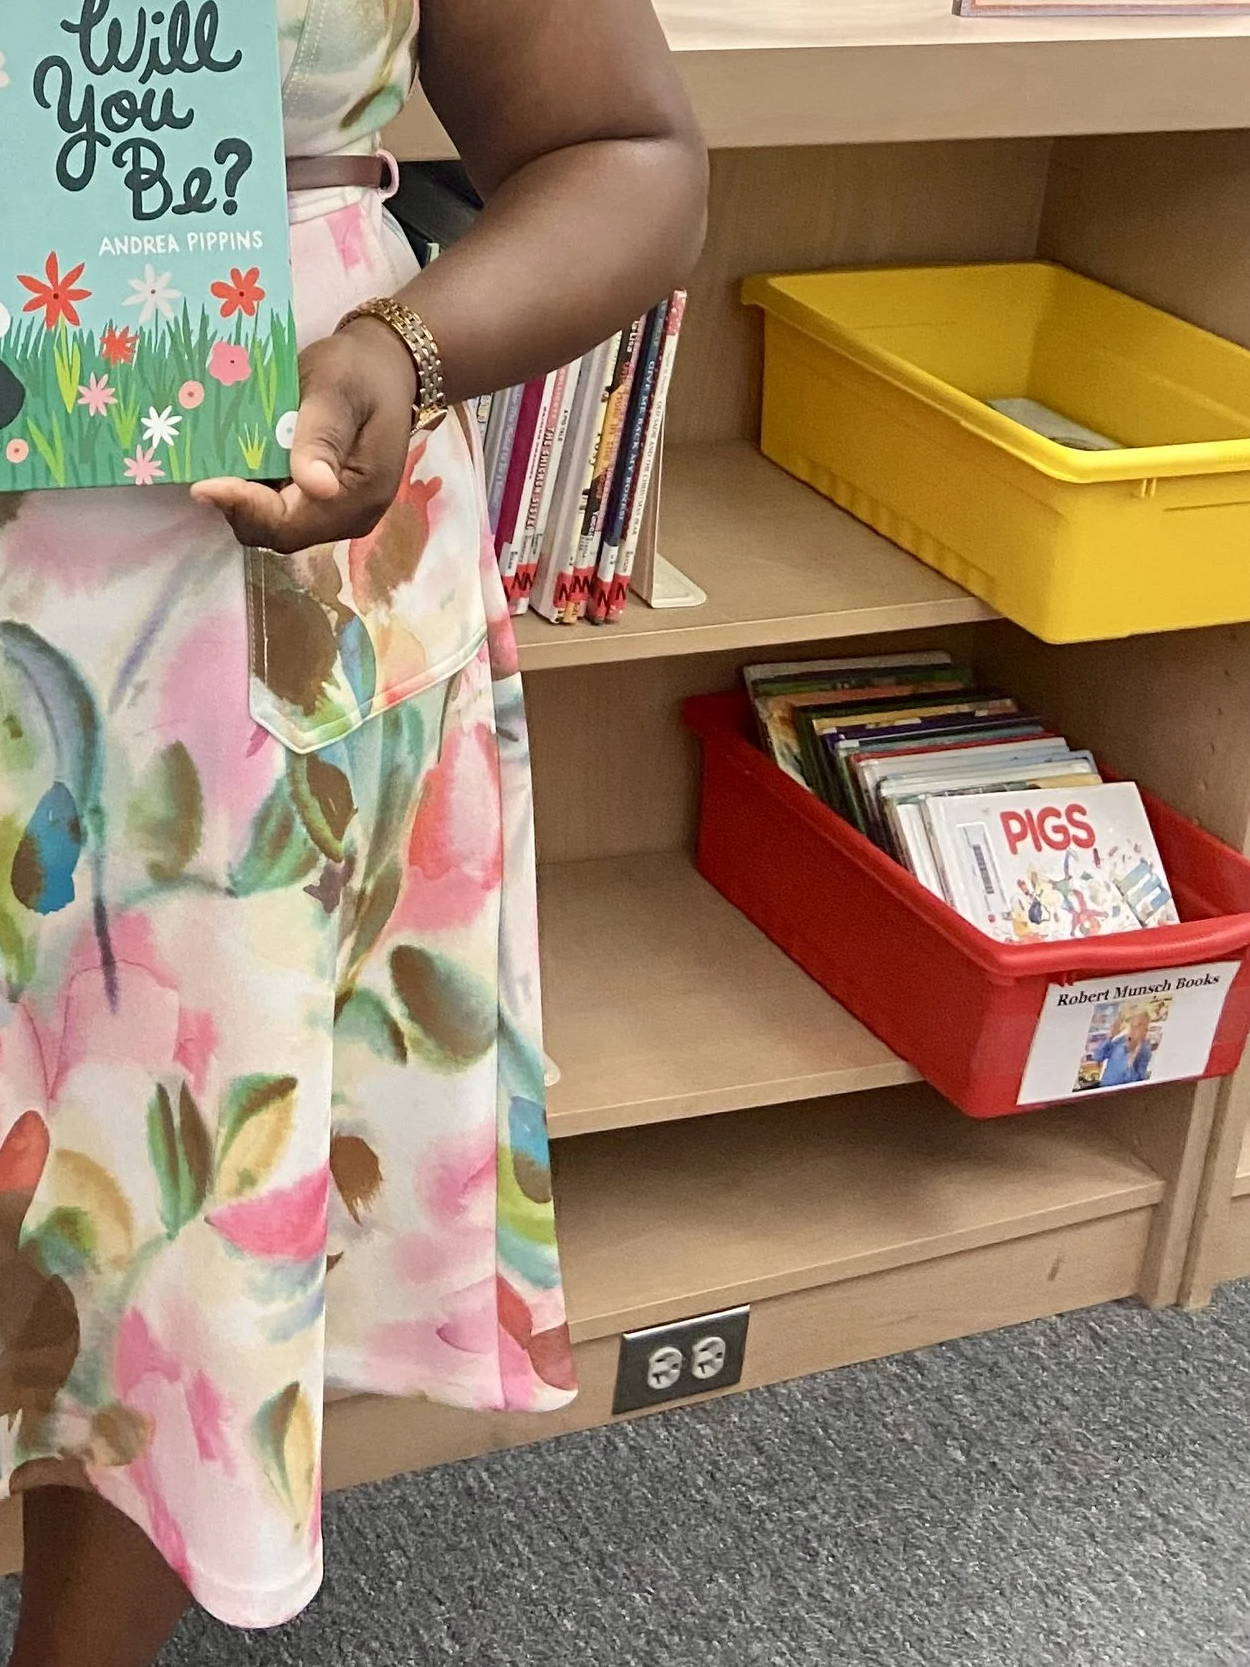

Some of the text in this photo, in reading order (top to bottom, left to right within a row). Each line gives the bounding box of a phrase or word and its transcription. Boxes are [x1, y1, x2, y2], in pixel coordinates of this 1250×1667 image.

[33, 55, 195, 192] You
[112, 137, 253, 222] Be?
[99, 230, 263, 257] ANDREA PIPPINS
[619, 361, 655, 521] GIVE ME BACK MY BONES!
[647, 440, 655, 458] AND
[651, 418, 660, 439] SADIE
[534, 426, 555, 493] THE CHICKEN
[643, 459, 651, 473] THE
[635, 474, 648, 516] CHRISTMAS
[1000, 803, 1097, 855] PIGS
[1057, 973, 1220, 1007] Robert Munsch Books
